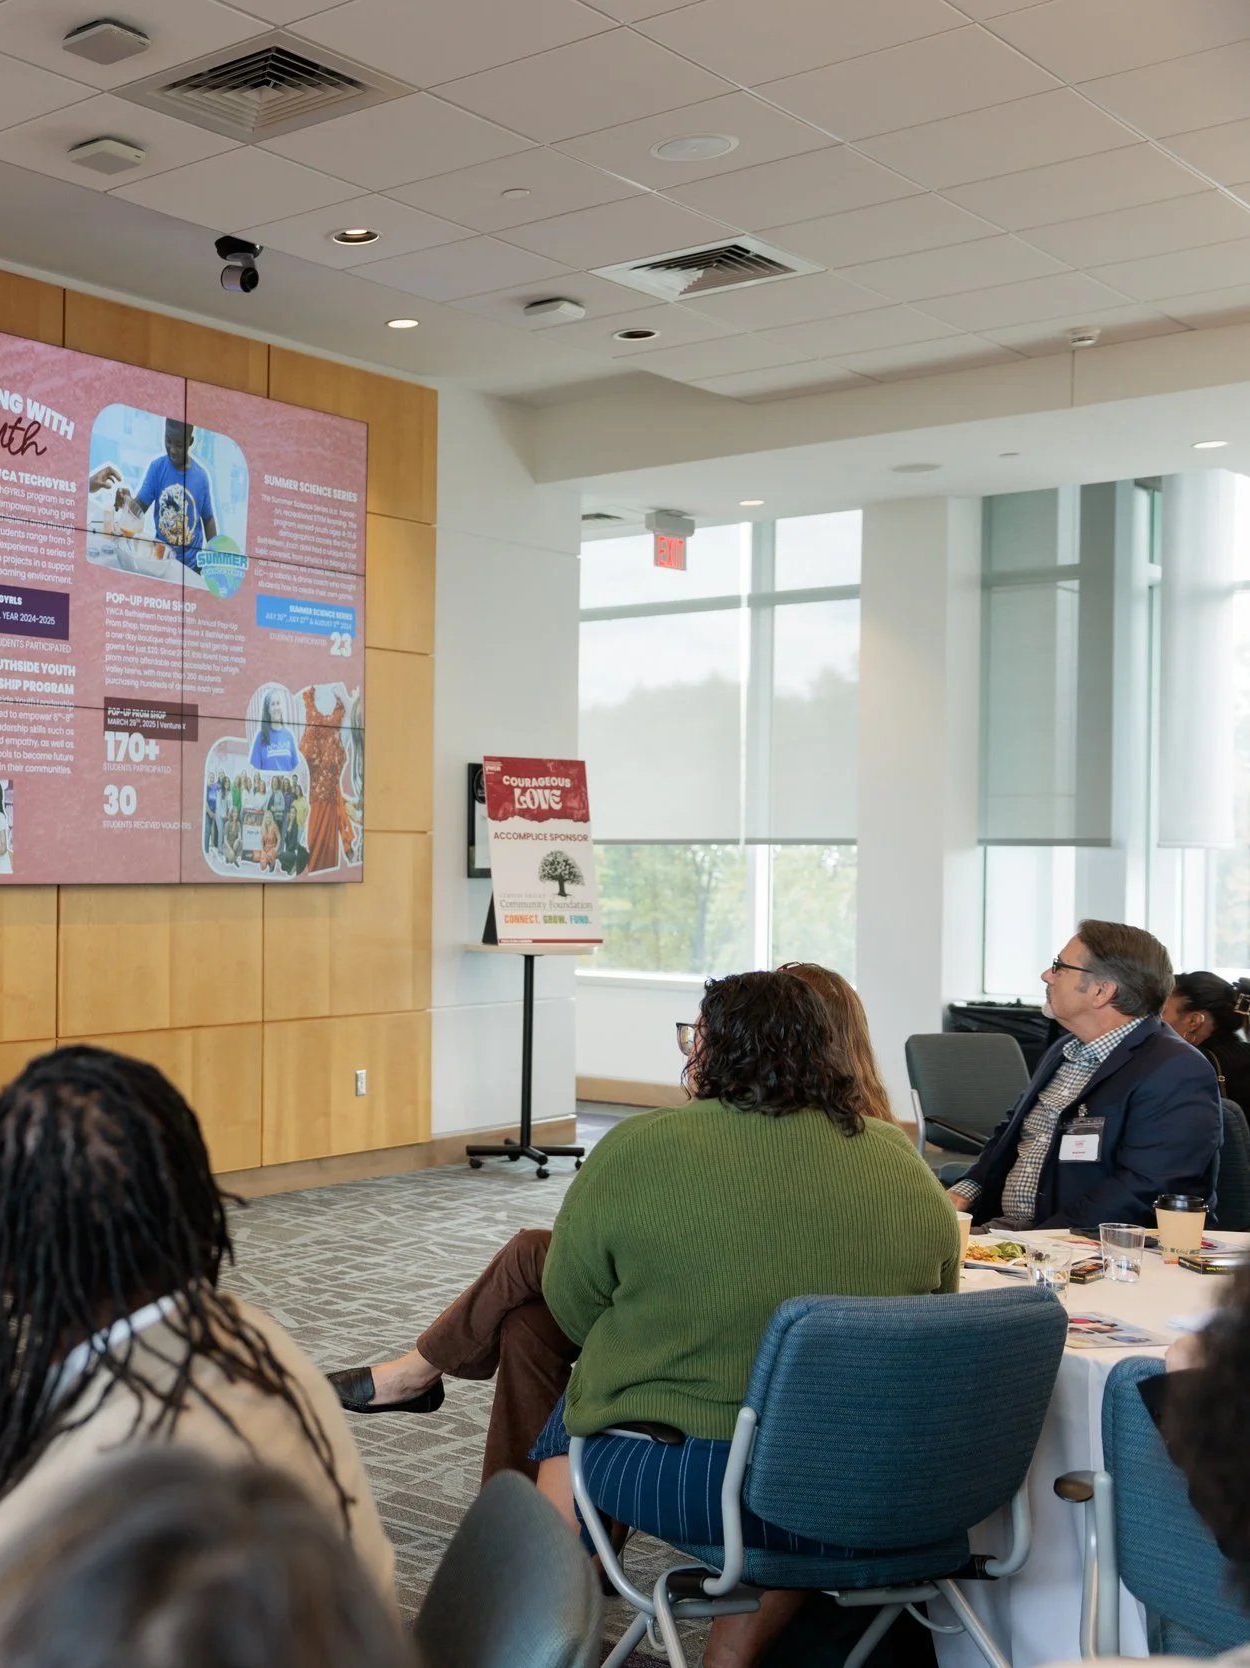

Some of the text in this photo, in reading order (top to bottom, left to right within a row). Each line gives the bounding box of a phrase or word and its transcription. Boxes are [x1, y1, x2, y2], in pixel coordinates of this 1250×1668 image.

[26, 398, 74, 440] WITH
[19, 472, 77, 492] TECHGYRLS
[264, 474, 358, 502] SUMMER SCIENCE SERIES
[27, 491, 57, 503] program
[38, 508, 59, 519] young
[60, 511, 75, 520] girls
[26, 531, 47, 543] range
[49, 534, 65, 544] from
[0, 541, 38, 554] experience
[46, 549, 66, 558] series
[658, 536, 684, 569] EXIT
[3, 555, 32, 567] projects
[34, 559, 40, 567] in
[48, 561, 74, 572] support
[198, 552, 248, 569] SUMMER
[28, 572, 73, 584] environment.
[106, 592, 197, 612] POP-UP PROM SHOP
[2, 611, 18, 621] YEAR
[20, 613, 55, 625] 2024-2025
[26, 640, 71, 653] PARTICIPATED
[330, 632, 352, 657] 23
[41, 664, 76, 677] YOUTH
[23, 681, 74, 695] PROGRAM
[10, 710, 17, 718] to
[18, 711, 51, 722] empower
[48, 727, 64, 735] such
[5, 737, 39, 748] empathy,
[105, 731, 159, 762] 170+
[23, 751, 53, 760] become
[53, 752, 74, 761] future
[0, 762, 6, 771] in
[8, 762, 23, 771] their
[25, 765, 71, 773] communities.
[502, 775, 571, 788] COURAGEOUS
[104, 784, 137, 816] 30
[514, 788, 562, 810] LOVE
[494, 832, 588, 841] ACCOMPLICE SPONSOR
[500, 900, 593, 909] Community Foundation
[504, 914, 591, 924] CONNECT. GROW. FUND.
